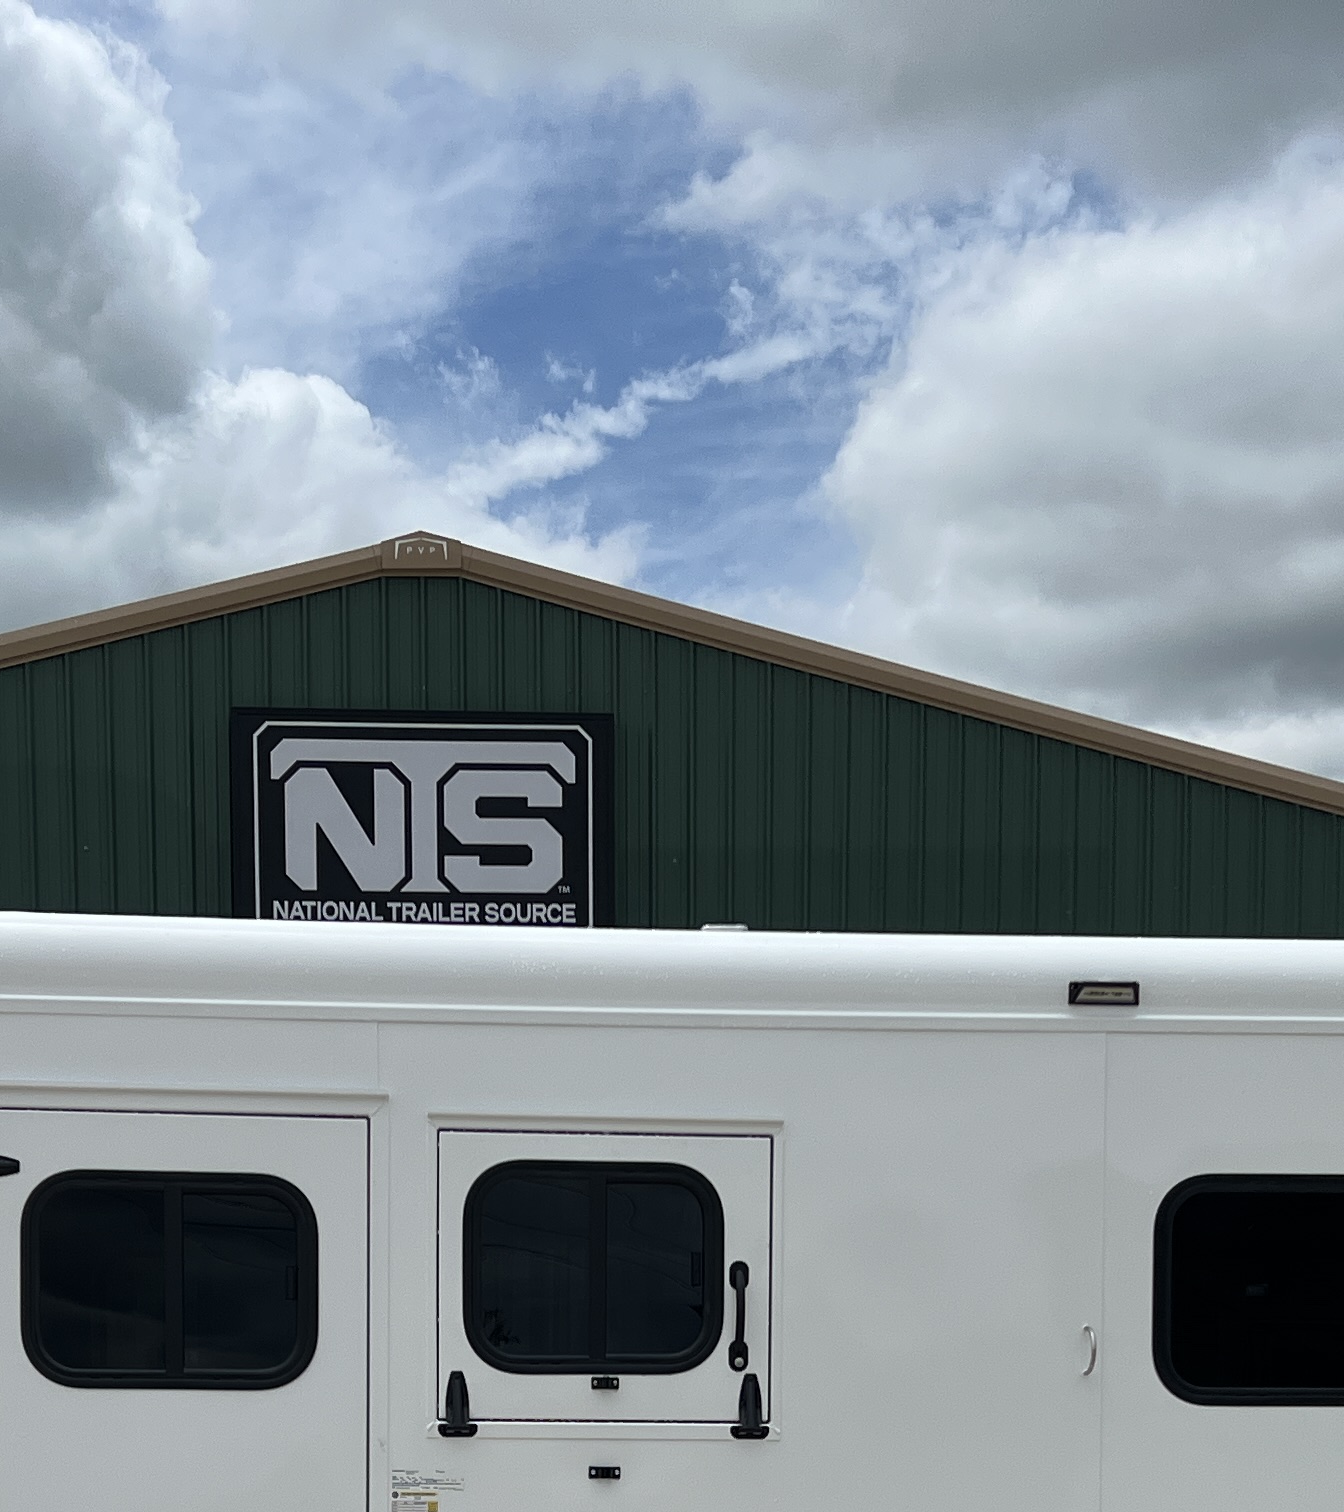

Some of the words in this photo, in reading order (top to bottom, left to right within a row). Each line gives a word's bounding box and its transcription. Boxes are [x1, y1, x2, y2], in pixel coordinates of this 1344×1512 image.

[269, 737, 576, 894] NTS
[272, 900, 384, 922] NATIONAL
[387, 901, 480, 923] TRAILER
[484, 902, 576, 924] SOURCE
